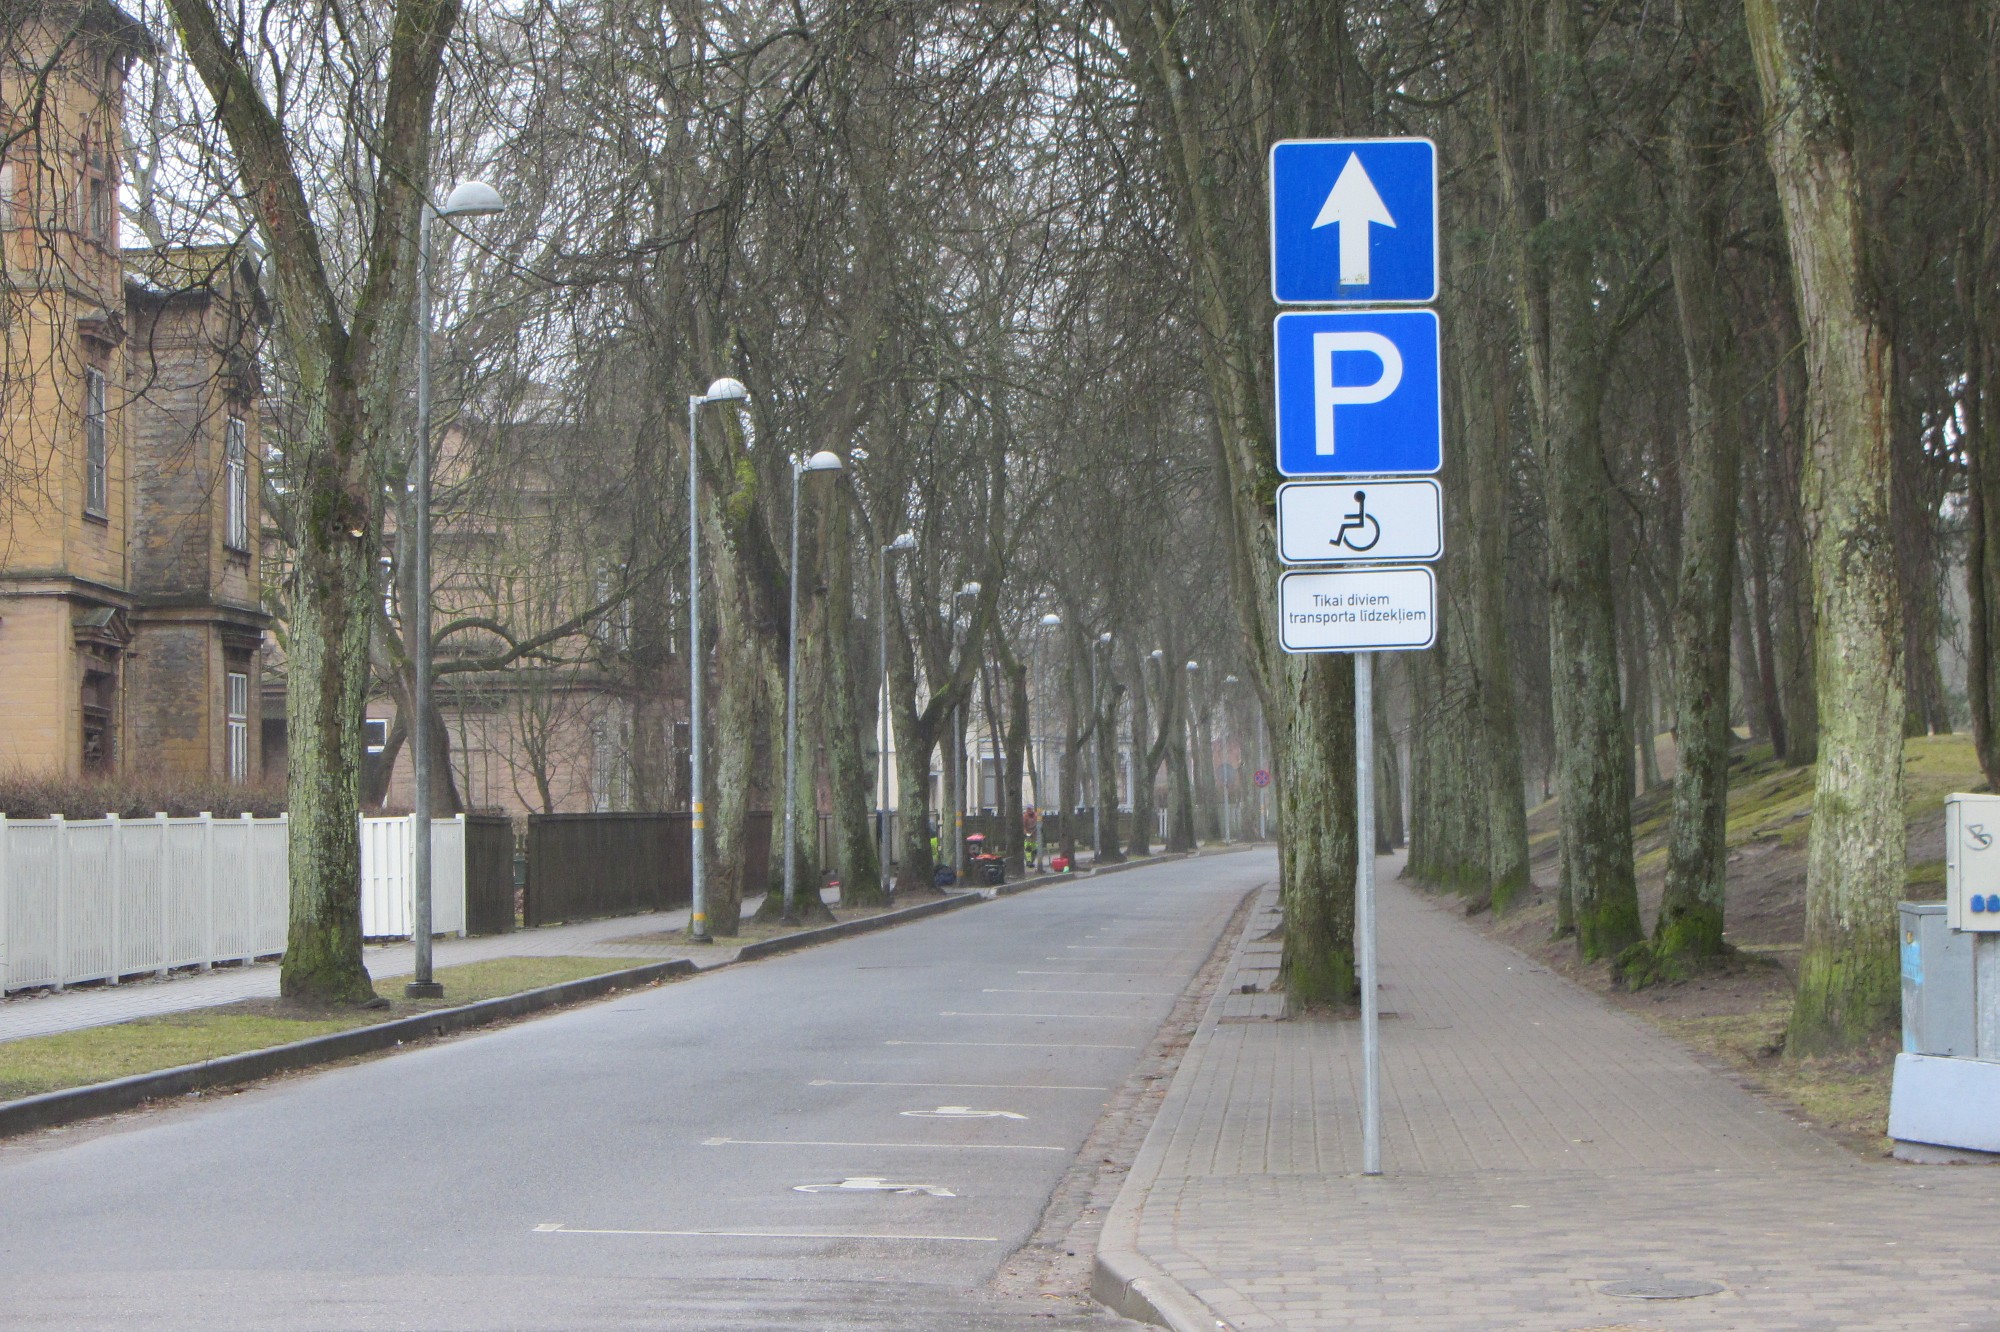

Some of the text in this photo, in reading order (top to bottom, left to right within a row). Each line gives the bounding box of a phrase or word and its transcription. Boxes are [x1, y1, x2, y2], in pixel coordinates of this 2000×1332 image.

[1313, 331, 1403, 456] P
[1312, 593, 1390, 607] Tikai diviem
[1289, 608, 1427, 626] transporta līdzekļiem
